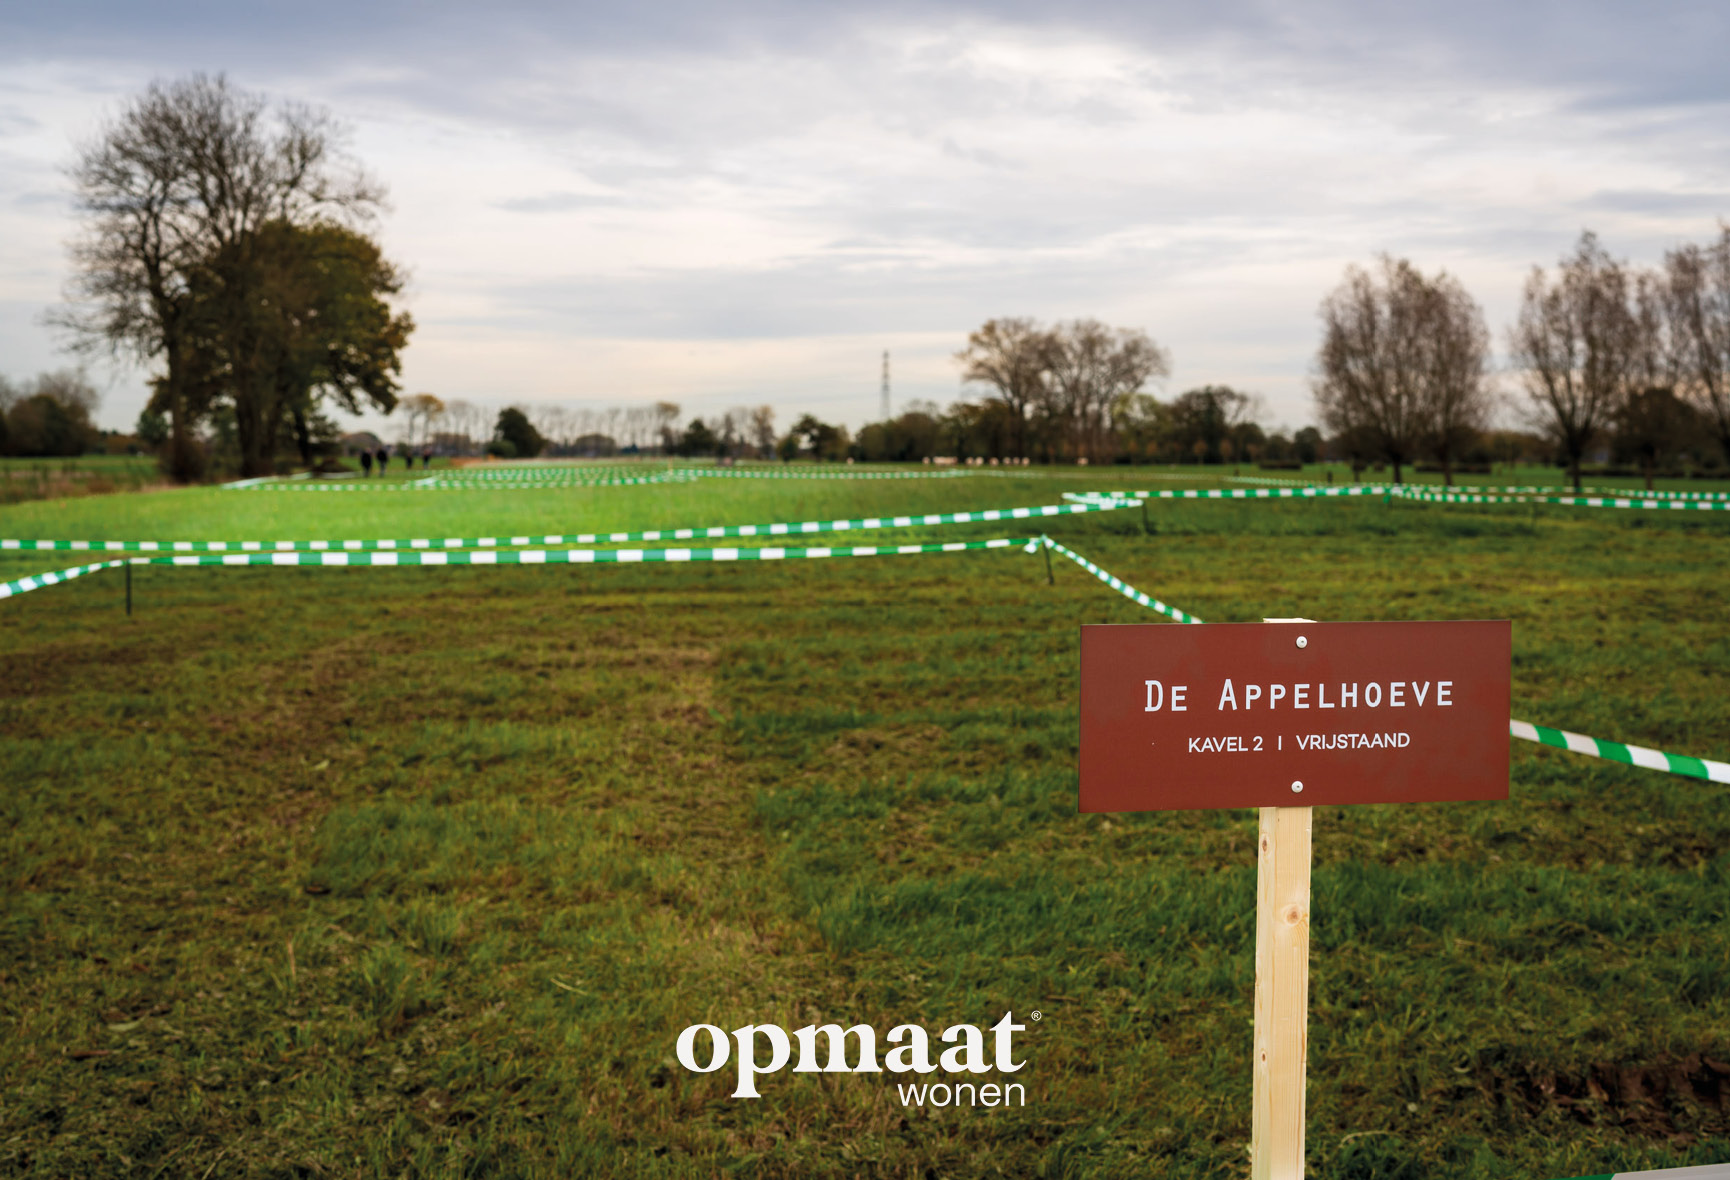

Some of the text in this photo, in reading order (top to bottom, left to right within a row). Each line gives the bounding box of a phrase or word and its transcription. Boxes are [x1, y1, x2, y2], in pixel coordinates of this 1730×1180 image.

[1188, 736, 1249, 753] KAVEL
[1252, 735, 1263, 752] 2
[1295, 732, 1411, 751] VRIJSTAAND
